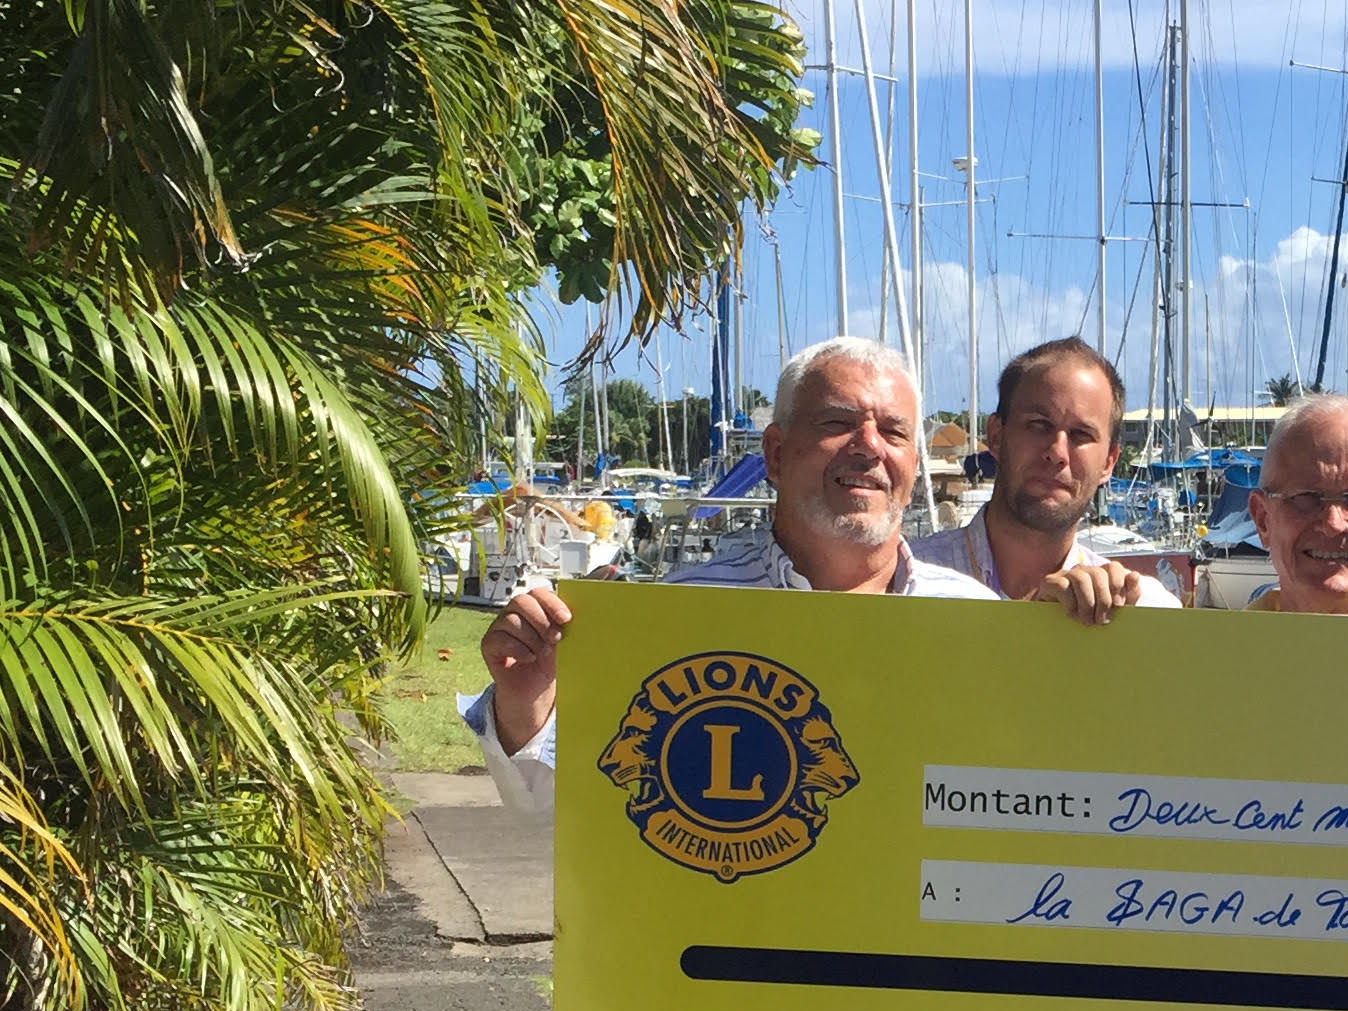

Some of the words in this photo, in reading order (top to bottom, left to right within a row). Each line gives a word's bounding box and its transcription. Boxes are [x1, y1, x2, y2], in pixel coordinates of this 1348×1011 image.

[657, 661, 804, 711] LIONS
[703, 724, 765, 800] L
[924, 782, 1092, 819] Montant:
[656, 820, 799, 864] INTERNATIONAL
[1006, 872, 1072, 924] la
[1257, 900, 1302, 928] de
